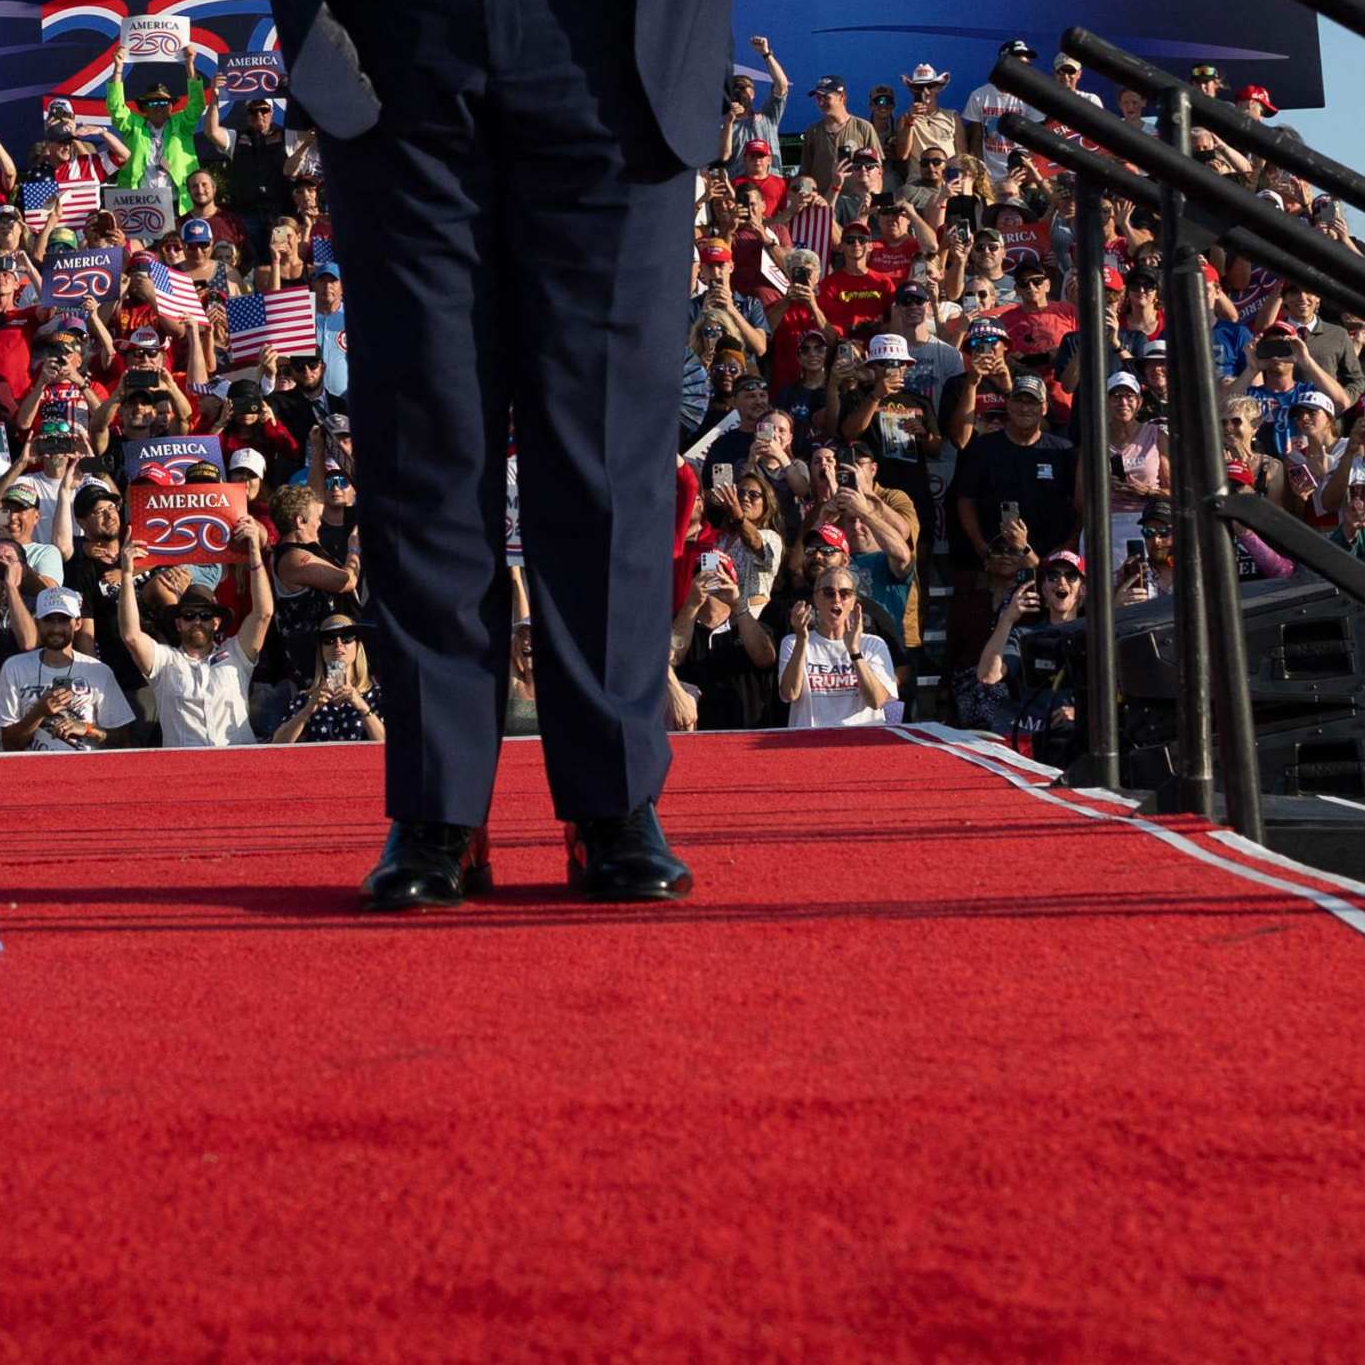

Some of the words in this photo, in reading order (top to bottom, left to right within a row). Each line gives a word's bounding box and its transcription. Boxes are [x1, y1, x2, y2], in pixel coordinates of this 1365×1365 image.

[129, 20, 180, 31] AMERICA
[129, 31, 182, 56] 250
[226, 56, 279, 67] AMERICA
[227, 68, 280, 92] 250
[113, 194, 162, 206] AMERICA
[114, 206, 165, 233] 250
[53, 254, 111, 270] AMERICA
[52, 267, 113, 298] 250
[981, 393, 1005, 404] USA
[138, 442, 208, 459] AMERICA
[145, 493, 230, 509] AMERICA
[146, 515, 231, 555] 250
[808, 661, 856, 675] TEAM
